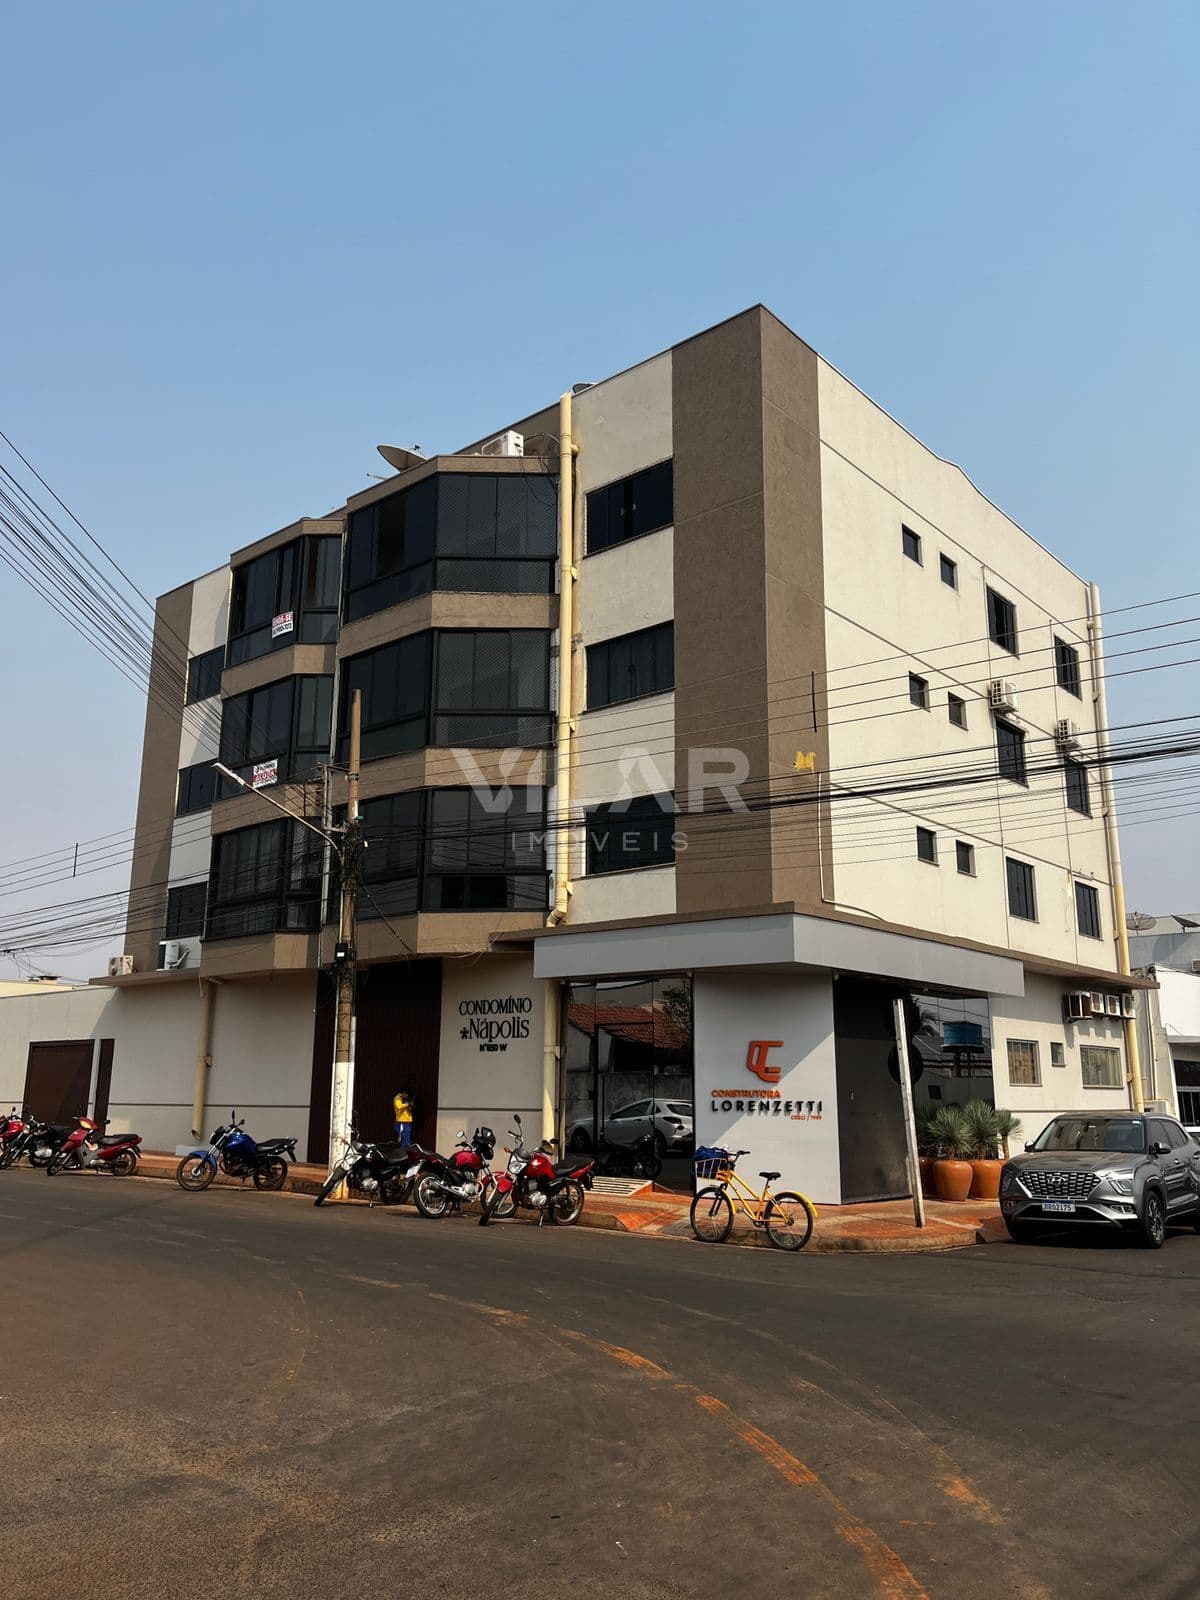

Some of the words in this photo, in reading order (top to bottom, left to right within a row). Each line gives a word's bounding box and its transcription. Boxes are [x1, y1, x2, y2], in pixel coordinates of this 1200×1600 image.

[459, 996, 532, 1016] CONDOMÍNIO
[711, 1089, 781, 1099] CONSTRUTORA
[711, 1100, 823, 1113] LORENZETTI
